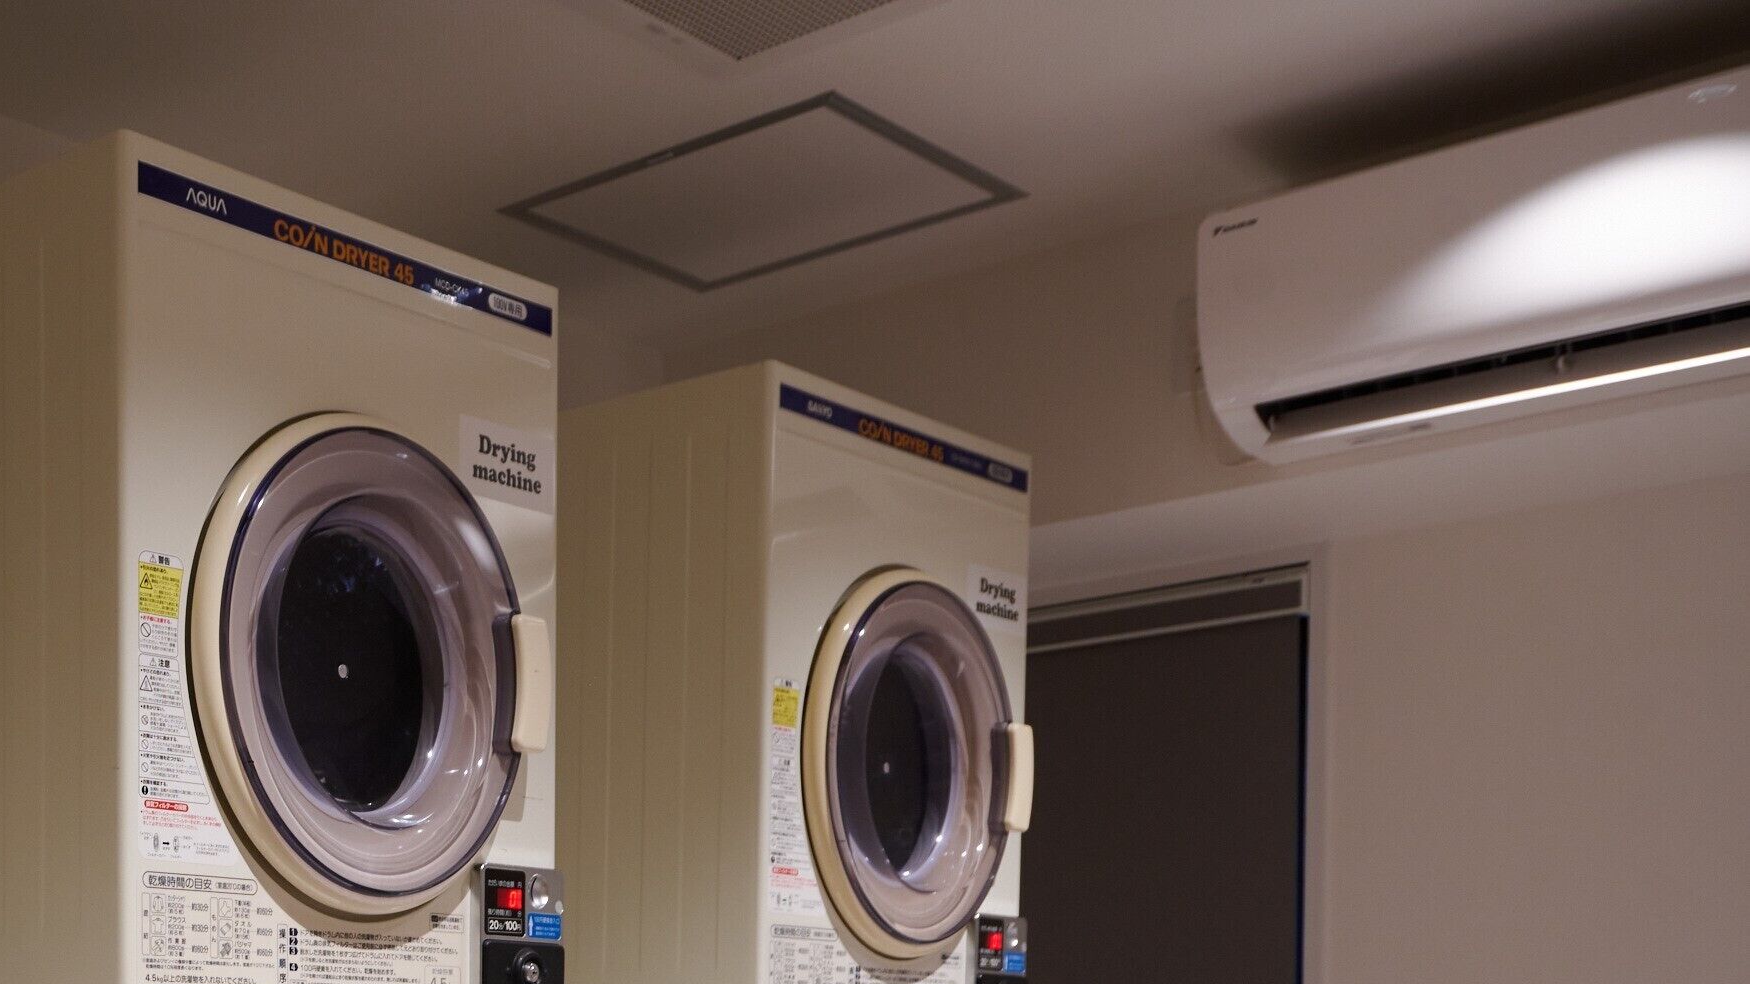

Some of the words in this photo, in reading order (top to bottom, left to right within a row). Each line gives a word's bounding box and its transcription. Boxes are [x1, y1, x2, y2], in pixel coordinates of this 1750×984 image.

[186, 187, 227, 215] AQUA
[332, 238, 390, 277] DRYER
[394, 262, 414, 286] 45
[479, 433, 537, 472] Drying
[472, 464, 542, 494] machine
[980, 577, 1016, 604] Drying
[976, 600, 1019, 622] machine
[148, 875, 212, 890] 乾燥時間の目安
